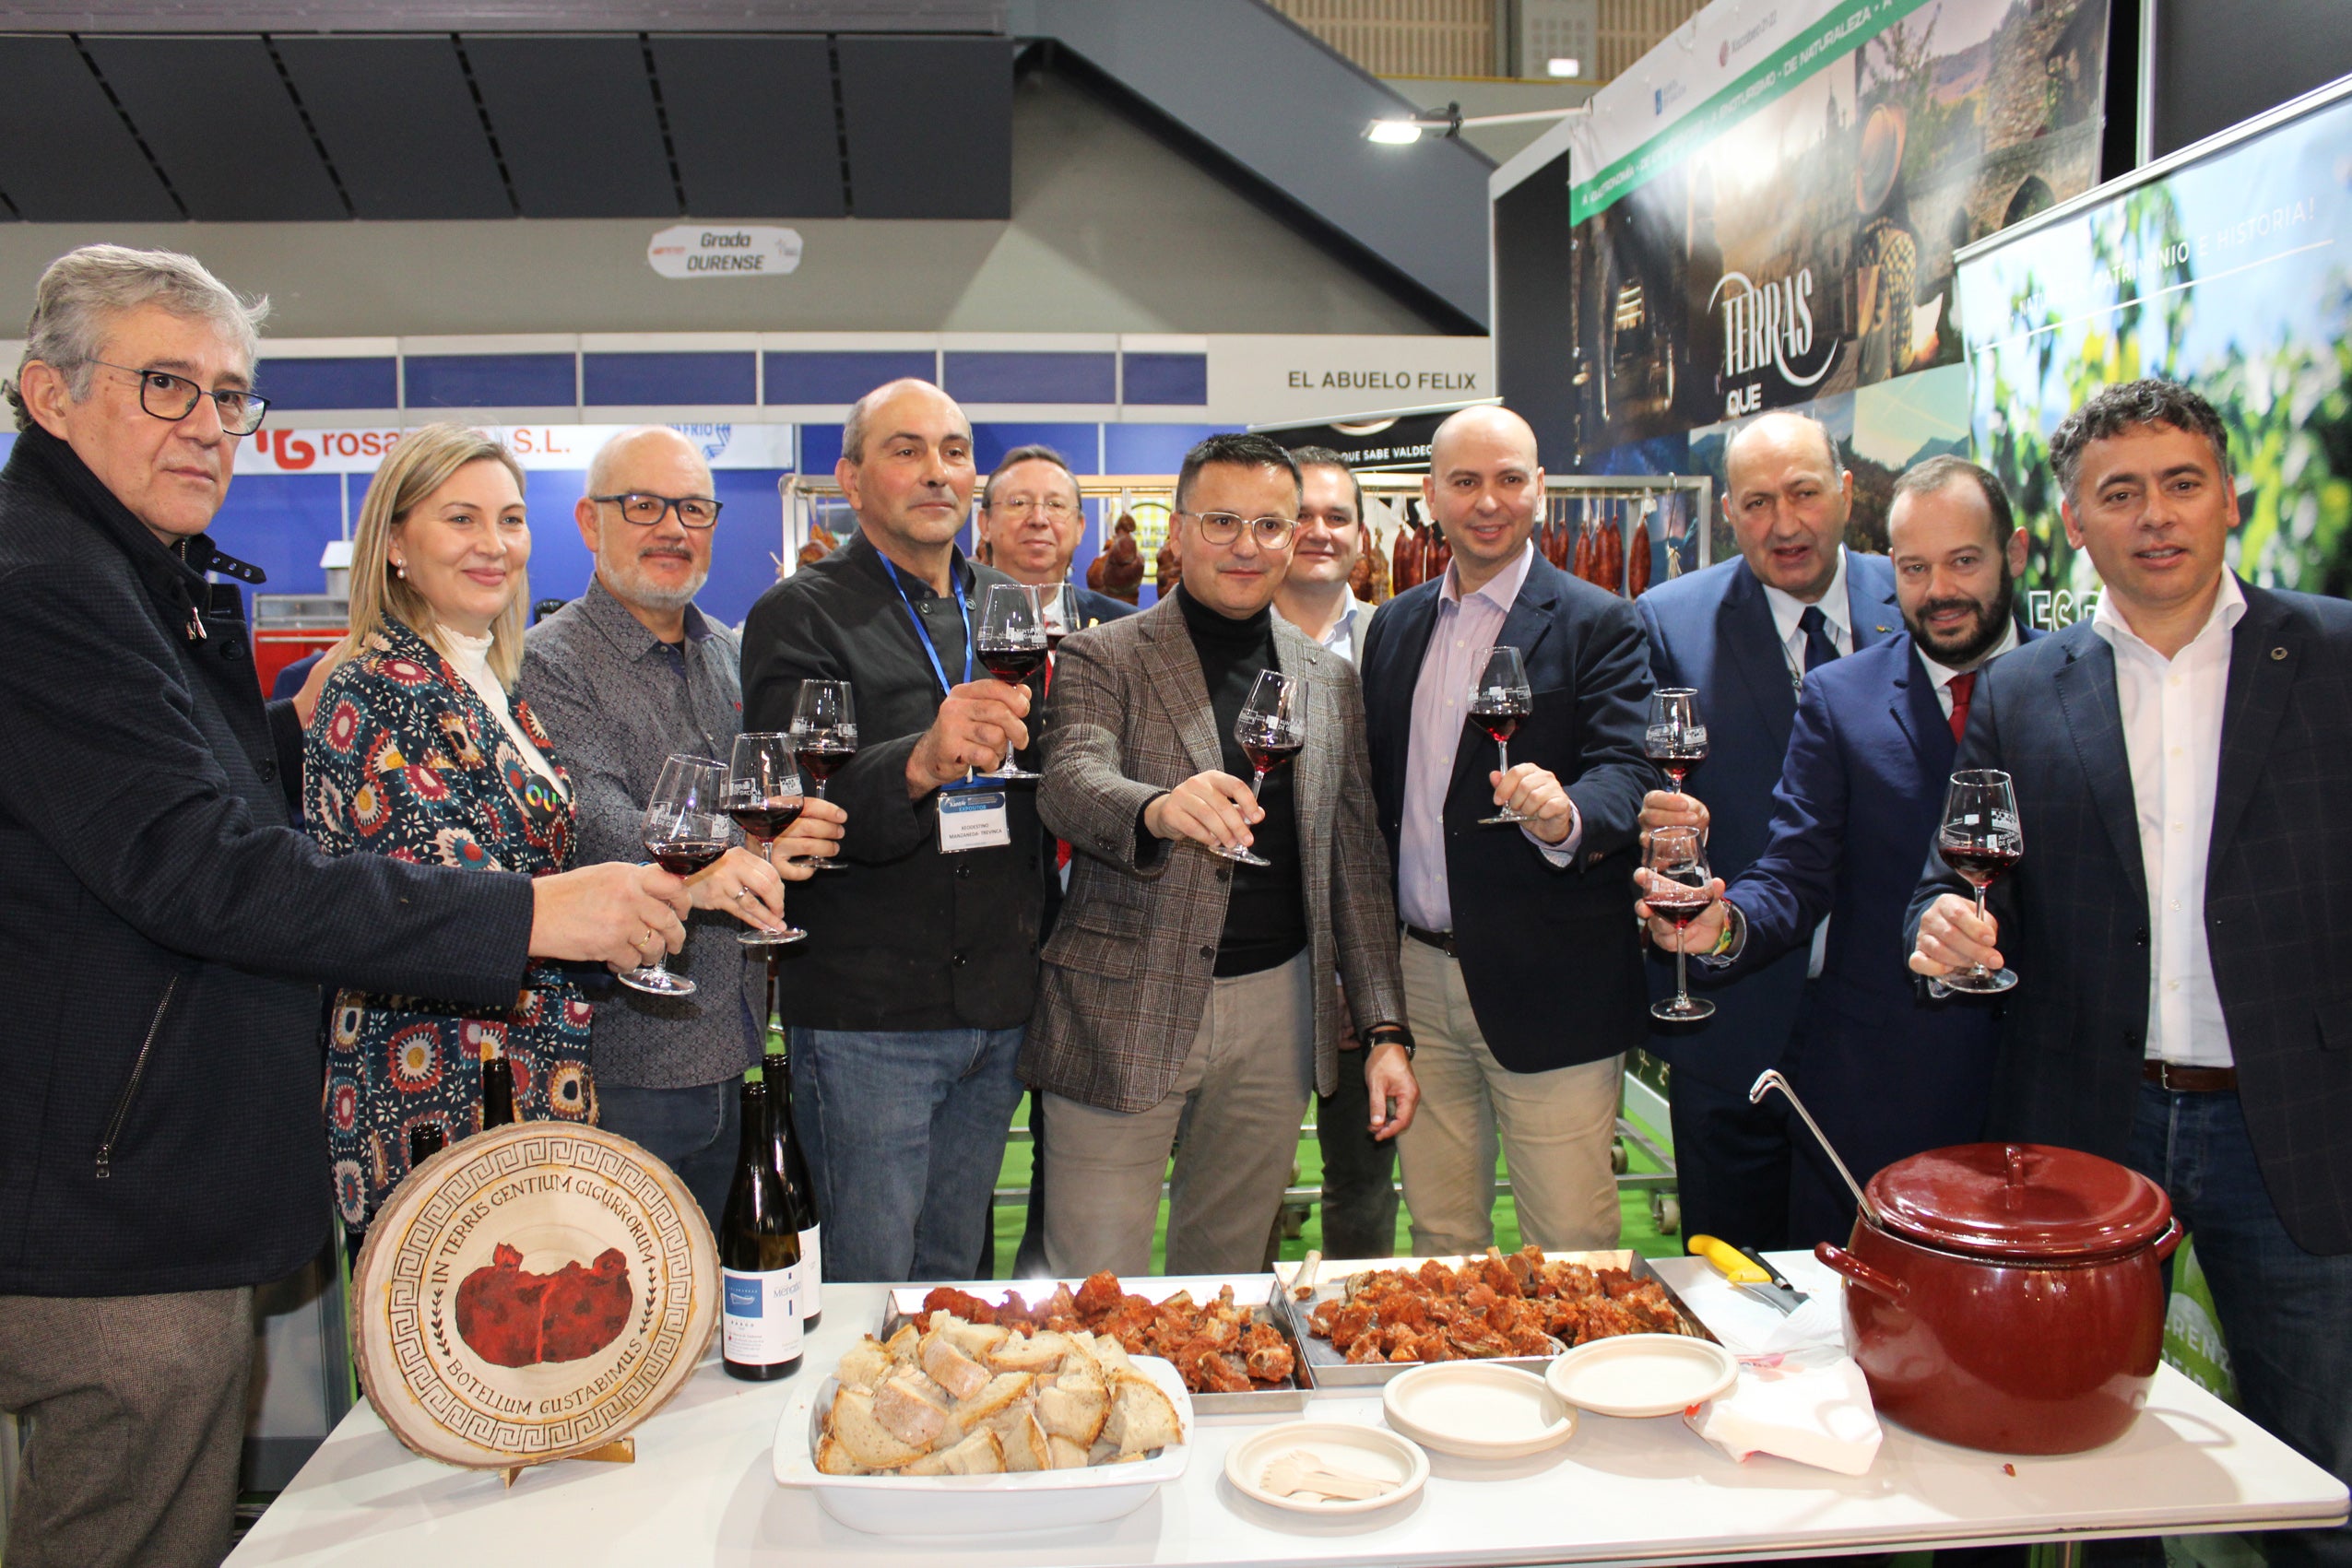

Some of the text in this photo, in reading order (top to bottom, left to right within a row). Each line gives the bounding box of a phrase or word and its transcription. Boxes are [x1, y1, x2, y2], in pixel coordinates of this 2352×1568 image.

[1783, 58, 1798, 77] DE
[1799, 6, 1872, 66] NATURALEZA
[701, 230, 751, 247] Grada
[2197, 235, 2209, 257] E
[2216, 196, 2317, 252] HISTORIA!
[686, 254, 764, 271] OURENSE
[1708, 267, 1839, 387] TERRAS
[1288, 371, 1477, 389] EL ABUELO FELIX
[1726, 383, 1762, 416] QUE
[323, 429, 400, 456] rosa
[513, 429, 572, 454] S.L.
[1363, 448, 1390, 461] SABE
[526, 784, 557, 812] OU
[431, 1173, 656, 1284] IN TERRIS GENTIUM GIGURRORUM
[446, 1338, 643, 1415] BOTELLUM GUSTABIMUS
